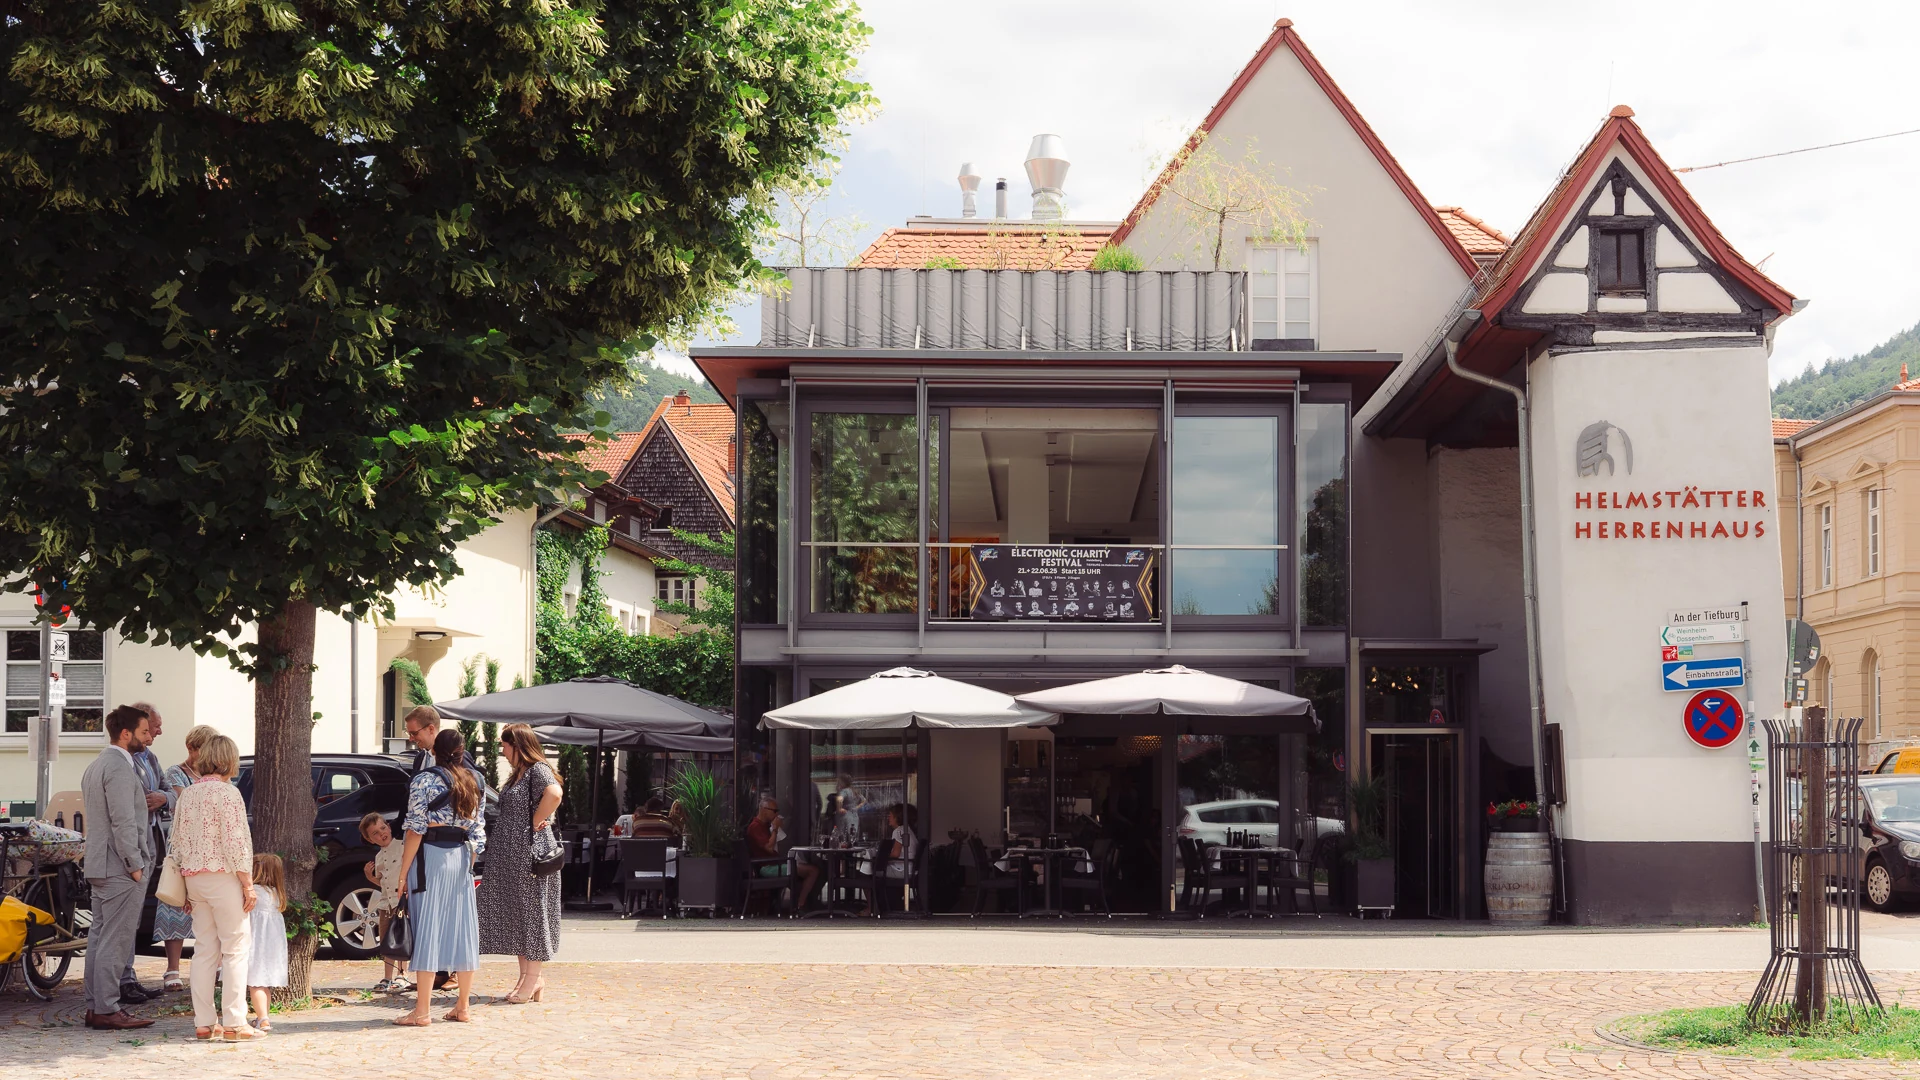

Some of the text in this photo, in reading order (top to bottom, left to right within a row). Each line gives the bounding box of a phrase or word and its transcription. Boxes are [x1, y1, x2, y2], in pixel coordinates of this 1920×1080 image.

[1575, 486, 1766, 509] HELMSTÄTTER
[1575, 521, 1765, 539] HERRENHAUS
[1011, 549, 1110, 558] ELECTRONIC CHARITY
[1041, 558, 1082, 567] FESTIVAL
[1674, 611, 1740, 622] An der Tiefburg
[145, 672, 152, 683] 2
[1685, 668, 1739, 679] Einbahnstraße
